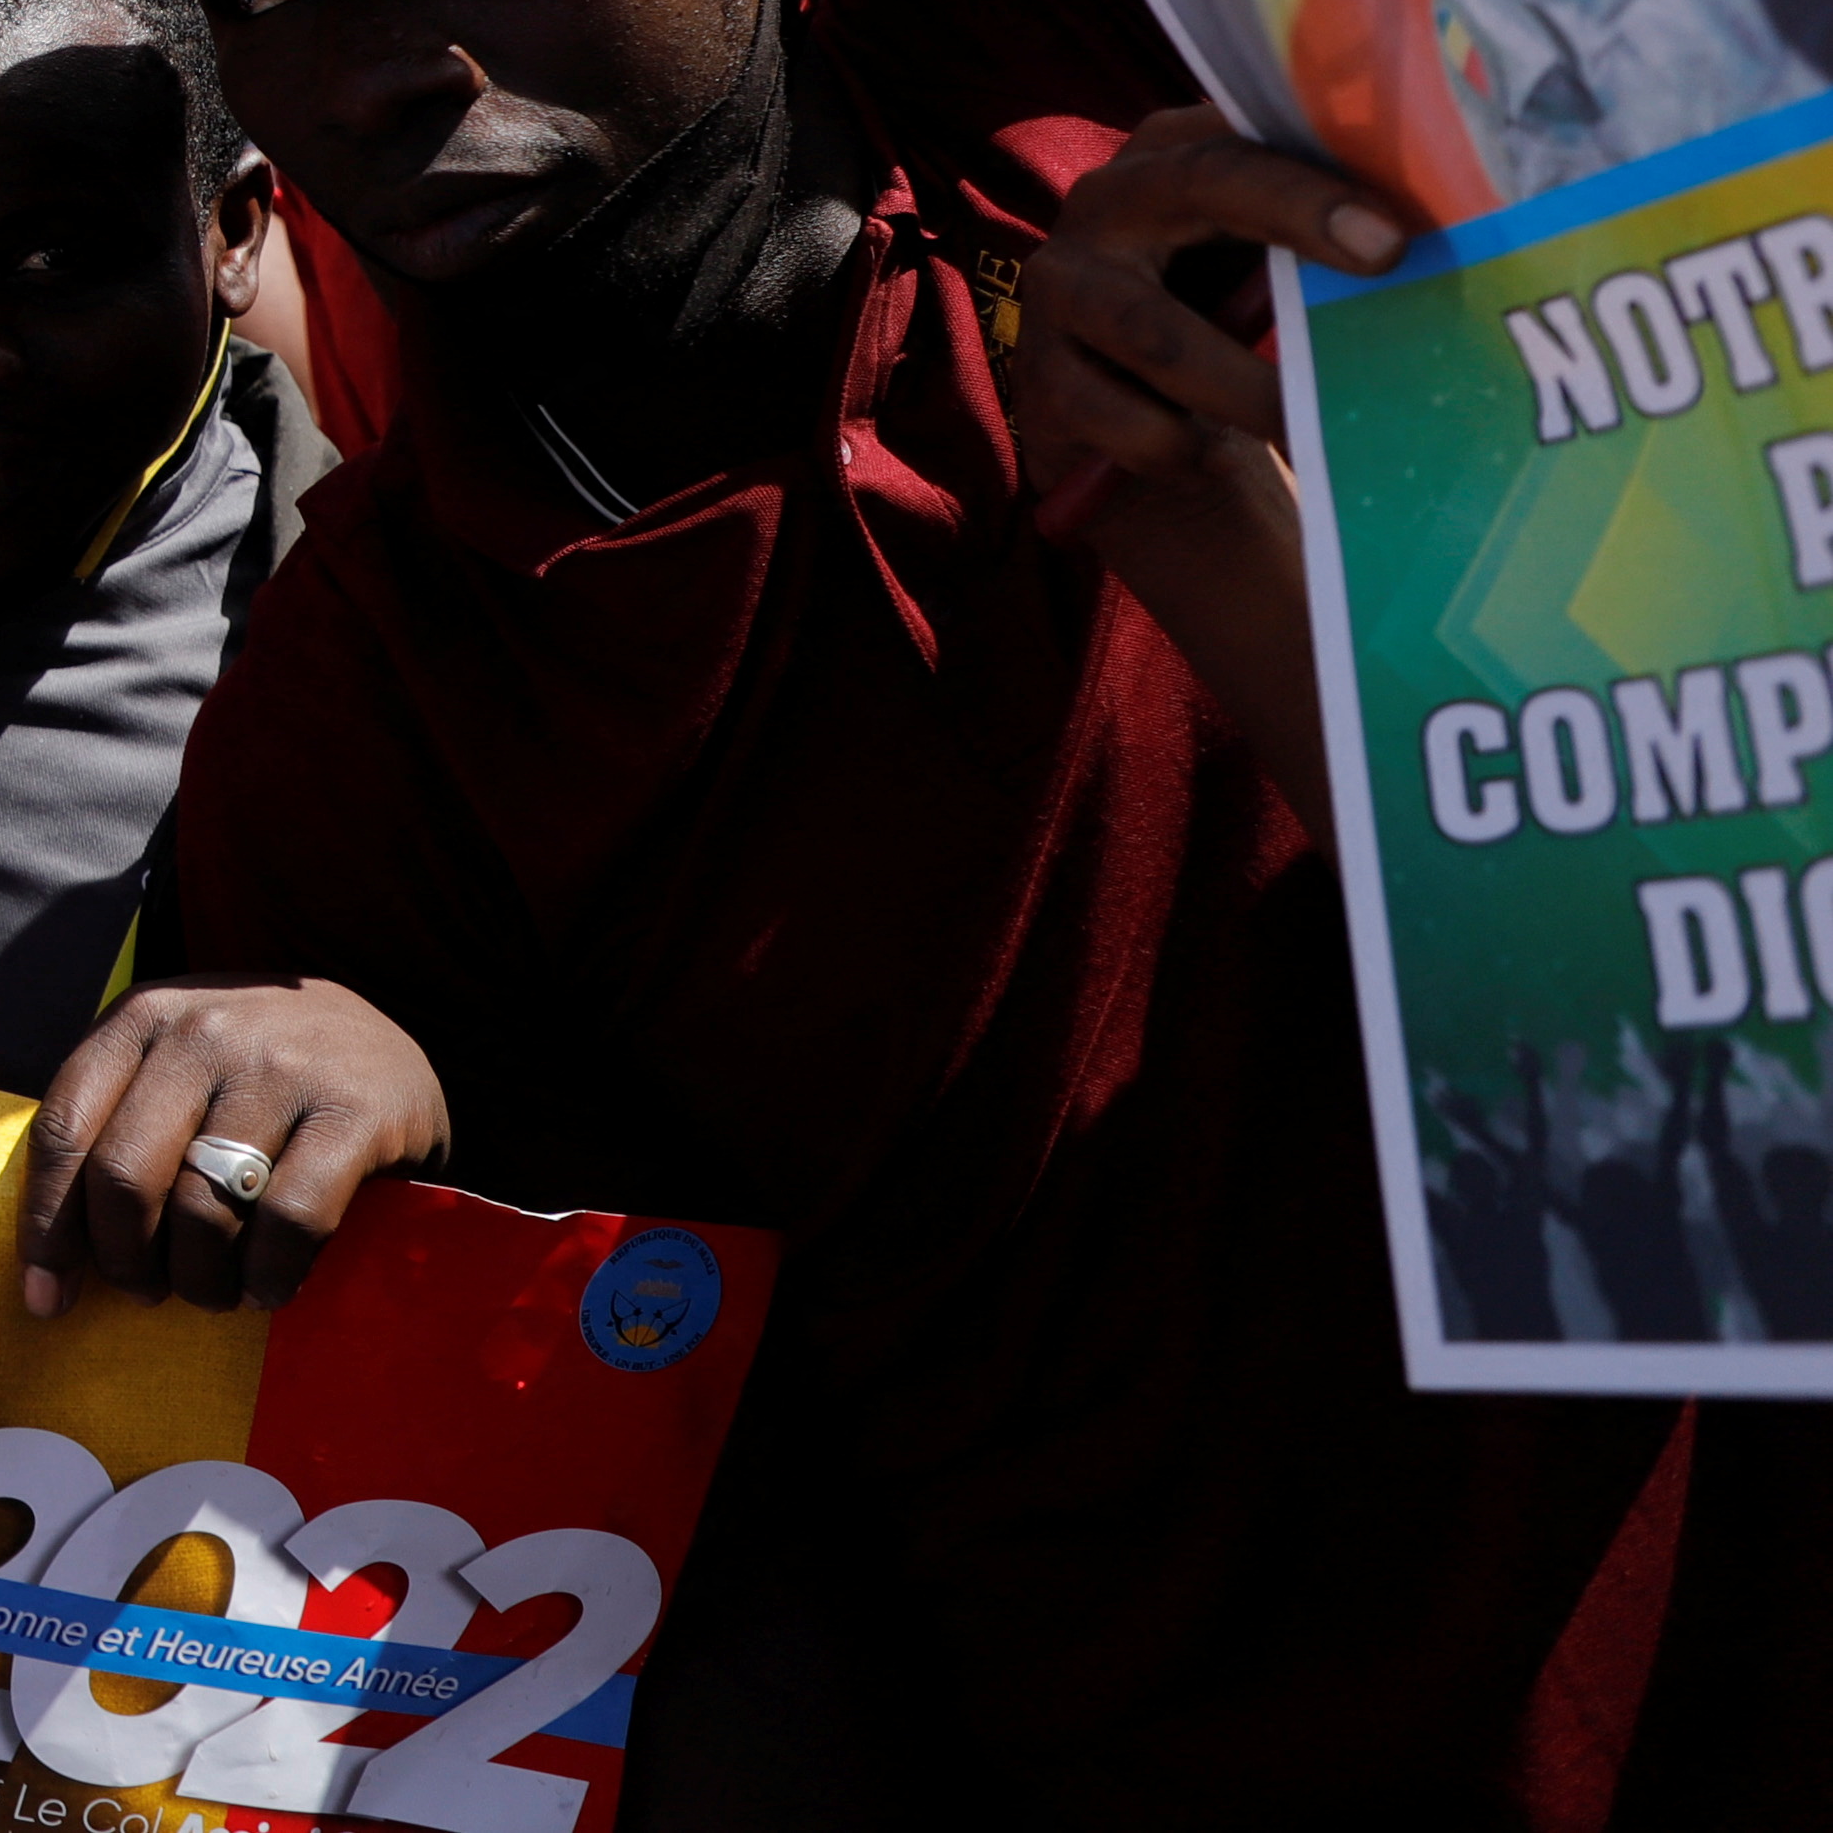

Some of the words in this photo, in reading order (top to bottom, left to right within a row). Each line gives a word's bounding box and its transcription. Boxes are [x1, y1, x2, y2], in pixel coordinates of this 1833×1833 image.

[608, 1228, 682, 1266] REPUBLIQUE
[682, 1233, 700, 1250] DU
[697, 1246, 717, 1277] MALI
[96, 1625, 144, 1658] et
[146, 1625, 332, 1686] Heureuse
[334, 1656, 460, 1701] Année
[13, 1782, 68, 1827] Le
